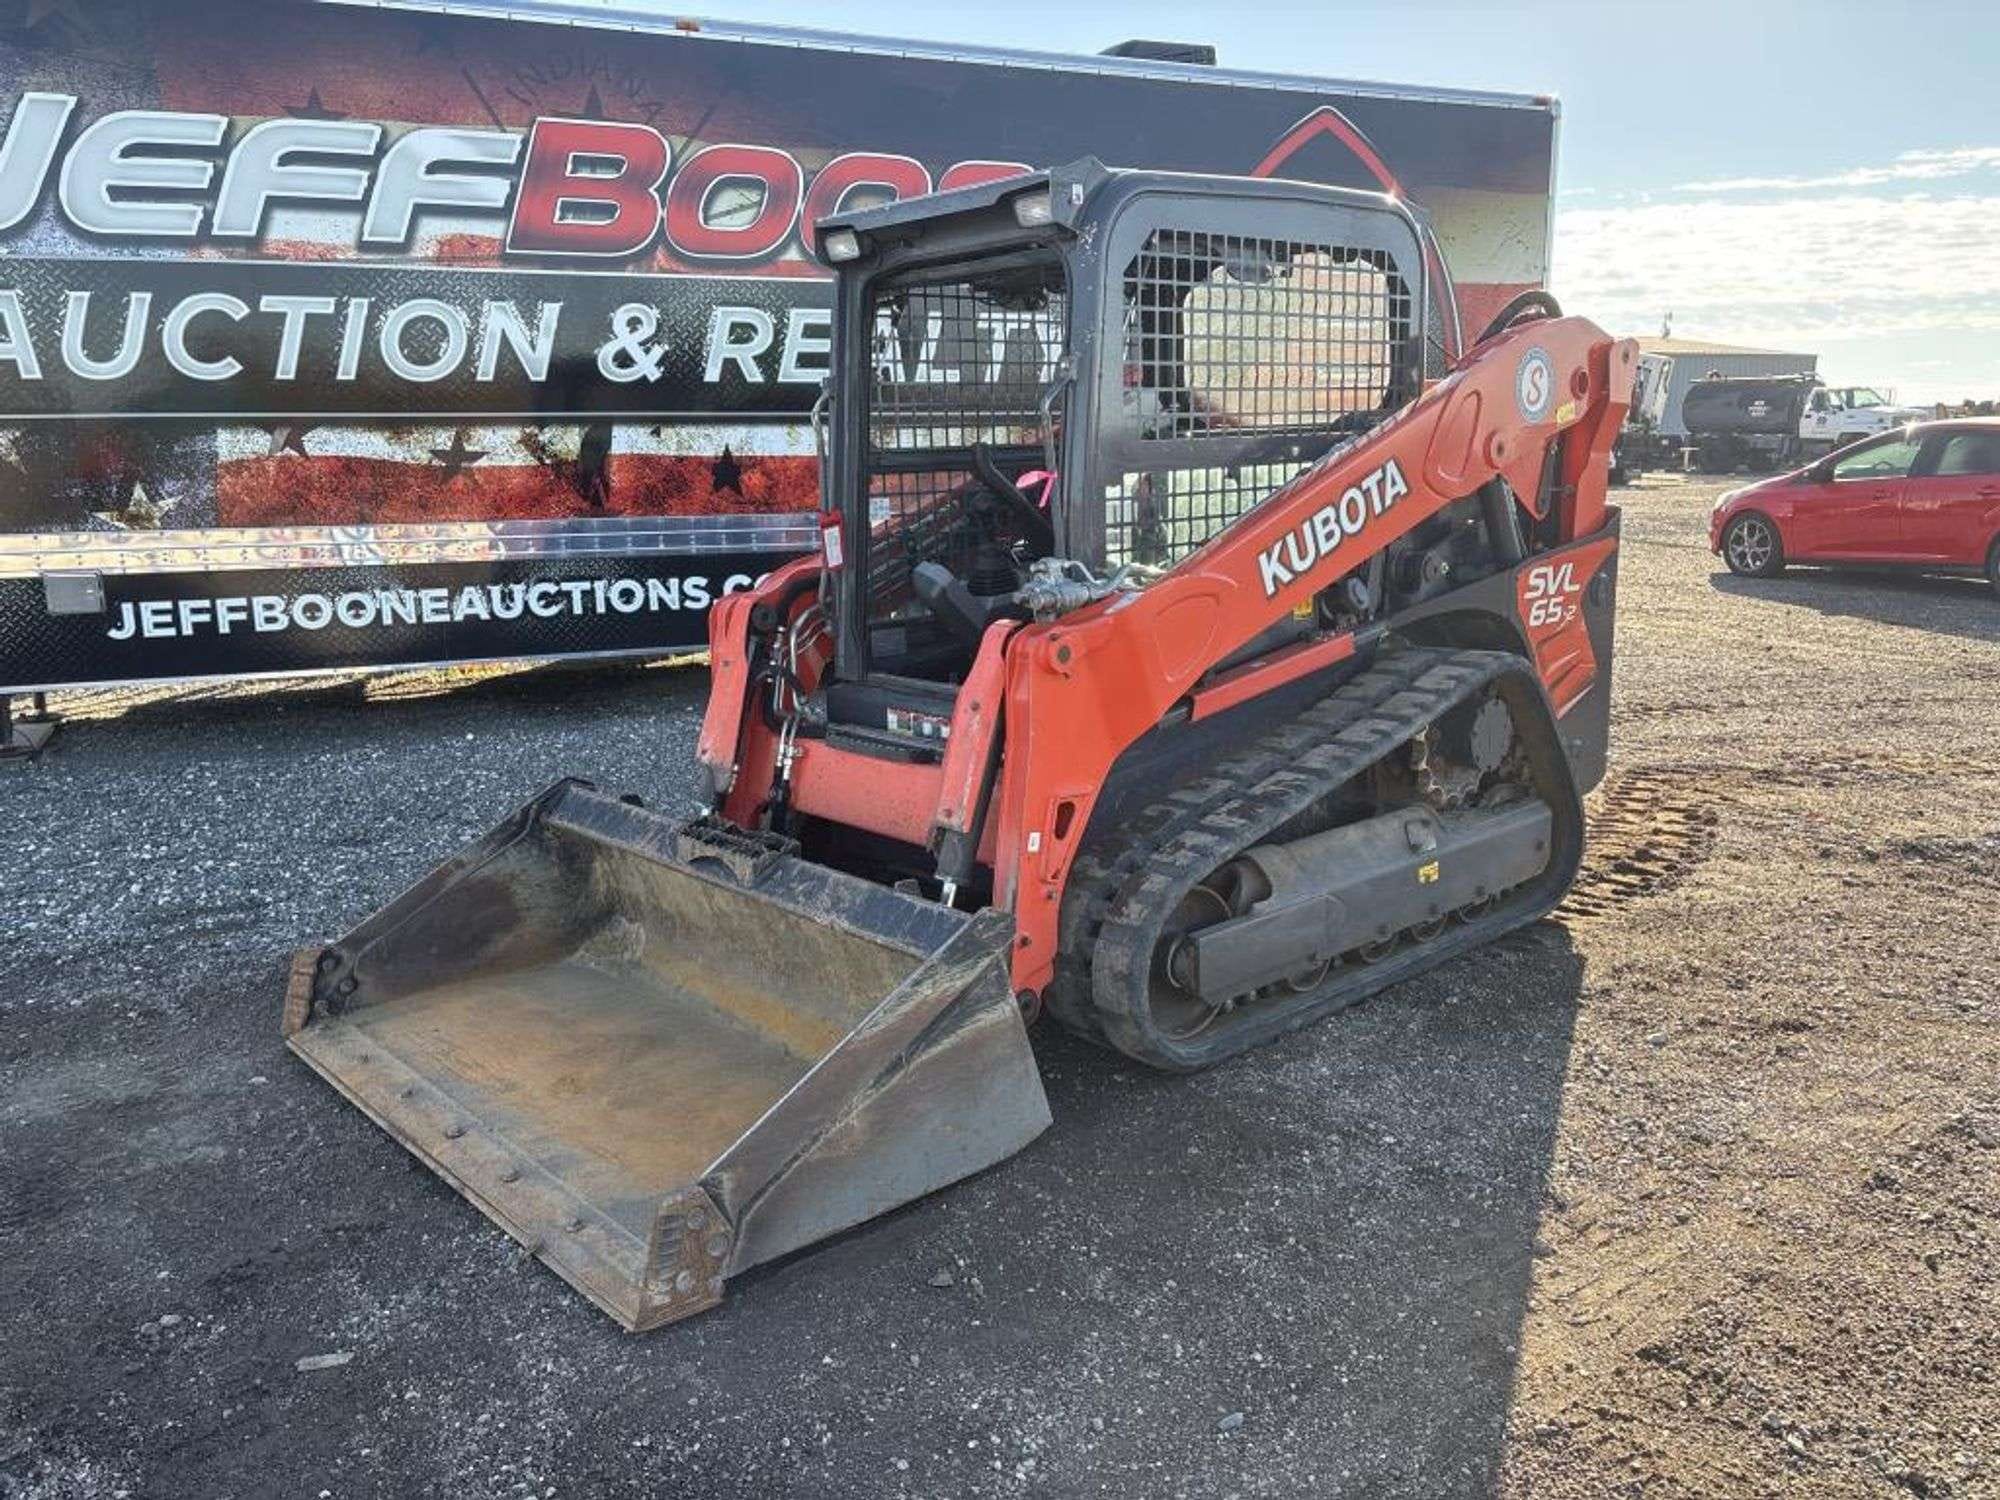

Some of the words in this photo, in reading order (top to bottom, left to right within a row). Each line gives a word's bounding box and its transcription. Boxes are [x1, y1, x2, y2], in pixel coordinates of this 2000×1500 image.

[505, 50, 666, 124] INDIANA
[595, 302, 669, 384] &
[1257, 458, 1409, 597] KUBOTA
[107, 572, 775, 641] JEFFBOONEAUCTIONSC
[1523, 561, 1580, 600] SVL
